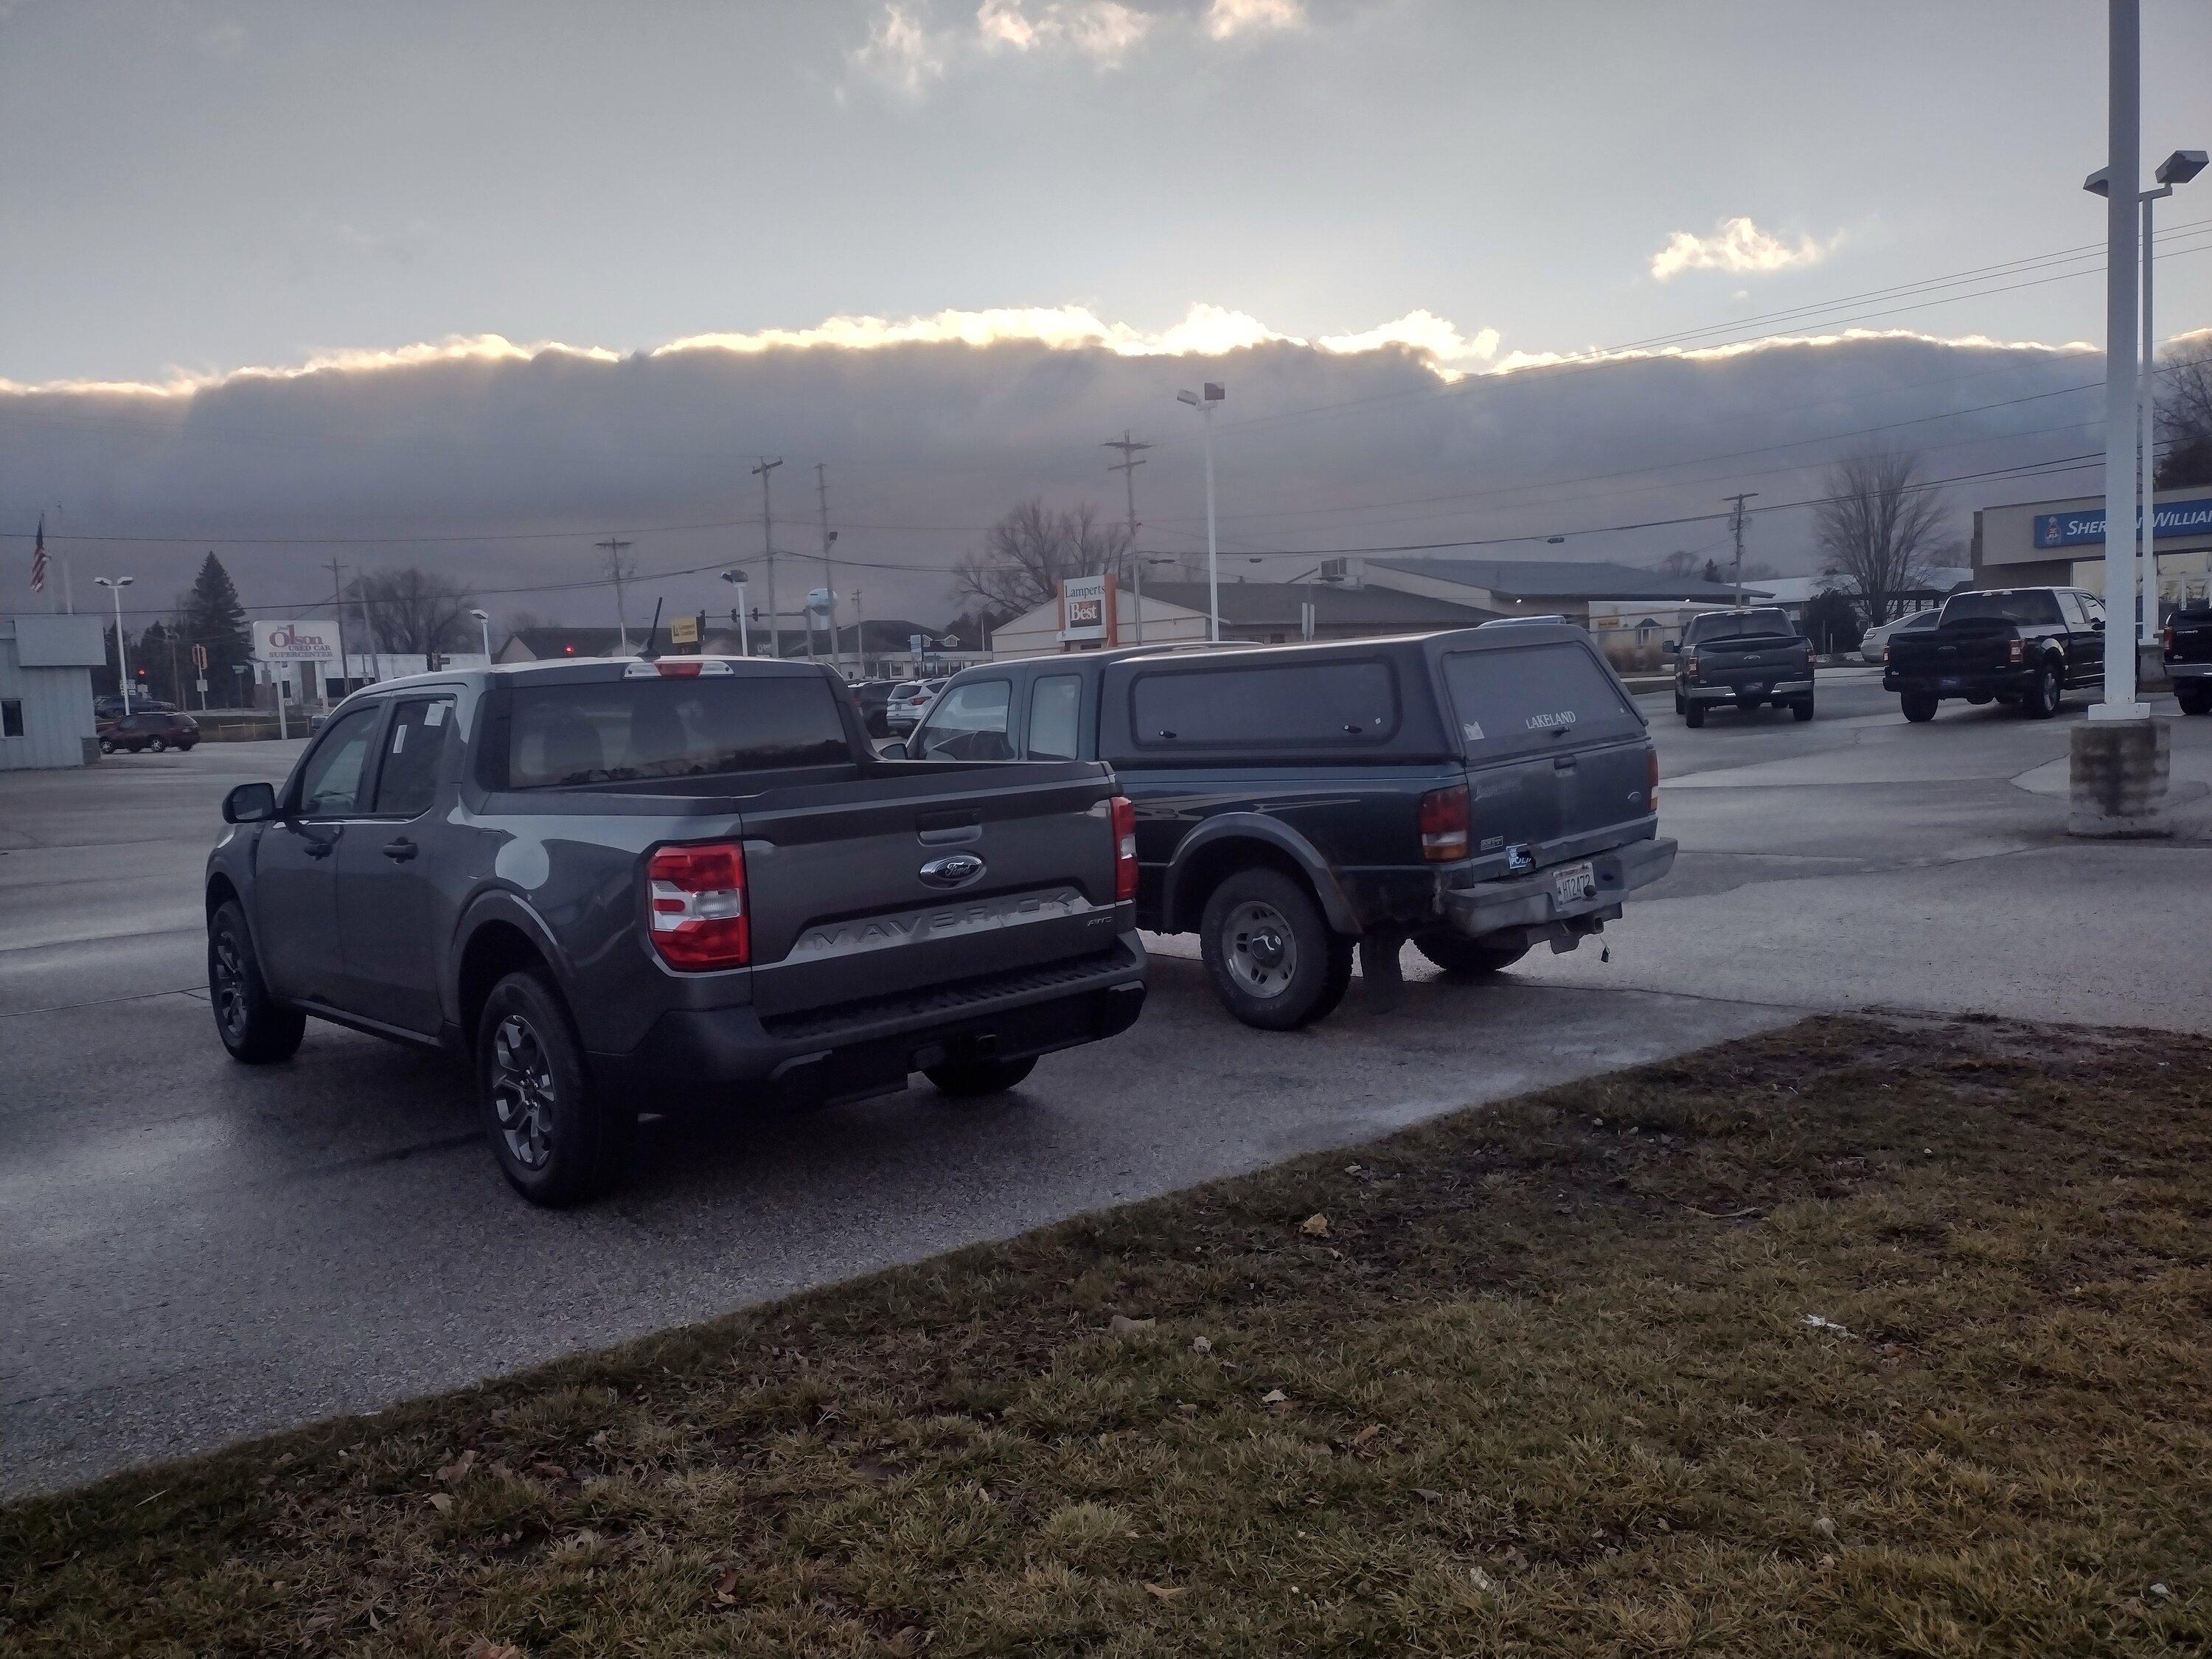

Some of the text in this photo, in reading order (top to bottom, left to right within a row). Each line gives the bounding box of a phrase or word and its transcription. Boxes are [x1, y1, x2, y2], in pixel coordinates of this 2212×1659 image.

[1065, 585, 1105, 599] Lamperts
[1071, 602, 1097, 621] Best
[269, 624, 324, 647] Olson
[1526, 711, 1576, 729] LAKELAND
[945, 861, 972, 876] Ford
[813, 891, 1071, 951] MAVERICK
